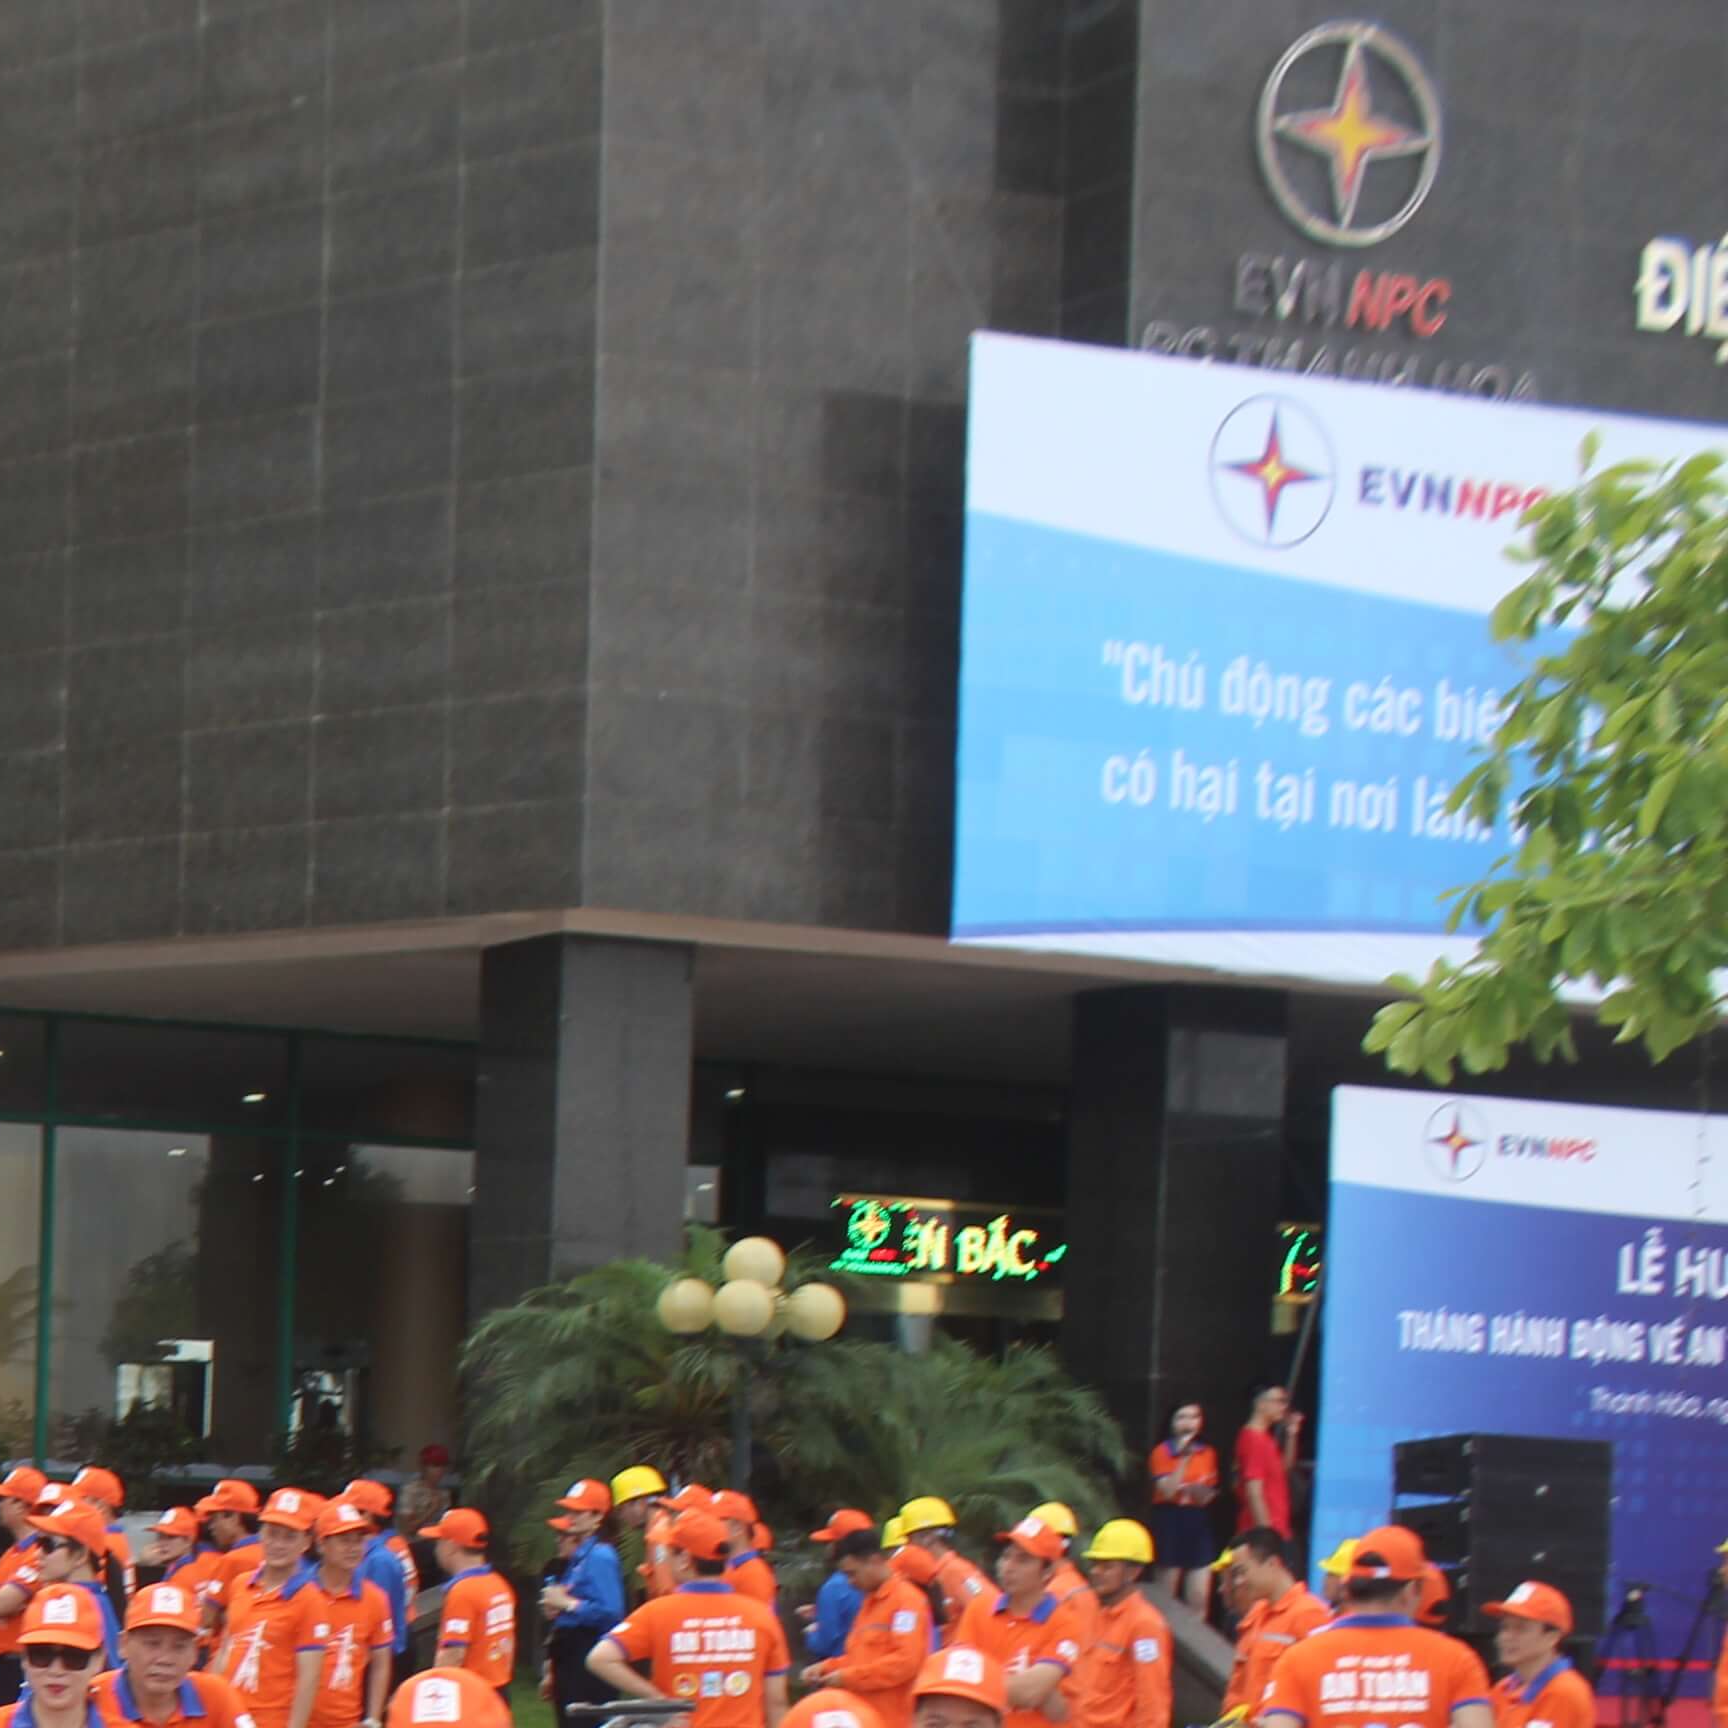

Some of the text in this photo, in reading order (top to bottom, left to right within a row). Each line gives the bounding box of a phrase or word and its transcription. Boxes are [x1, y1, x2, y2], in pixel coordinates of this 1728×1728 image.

[1221, 655, 1331, 738] động
[1345, 674, 1423, 736] các
[1103, 748, 1158, 804] có
[1170, 750, 1239, 823] hại
[1256, 761, 1316, 830] tại
